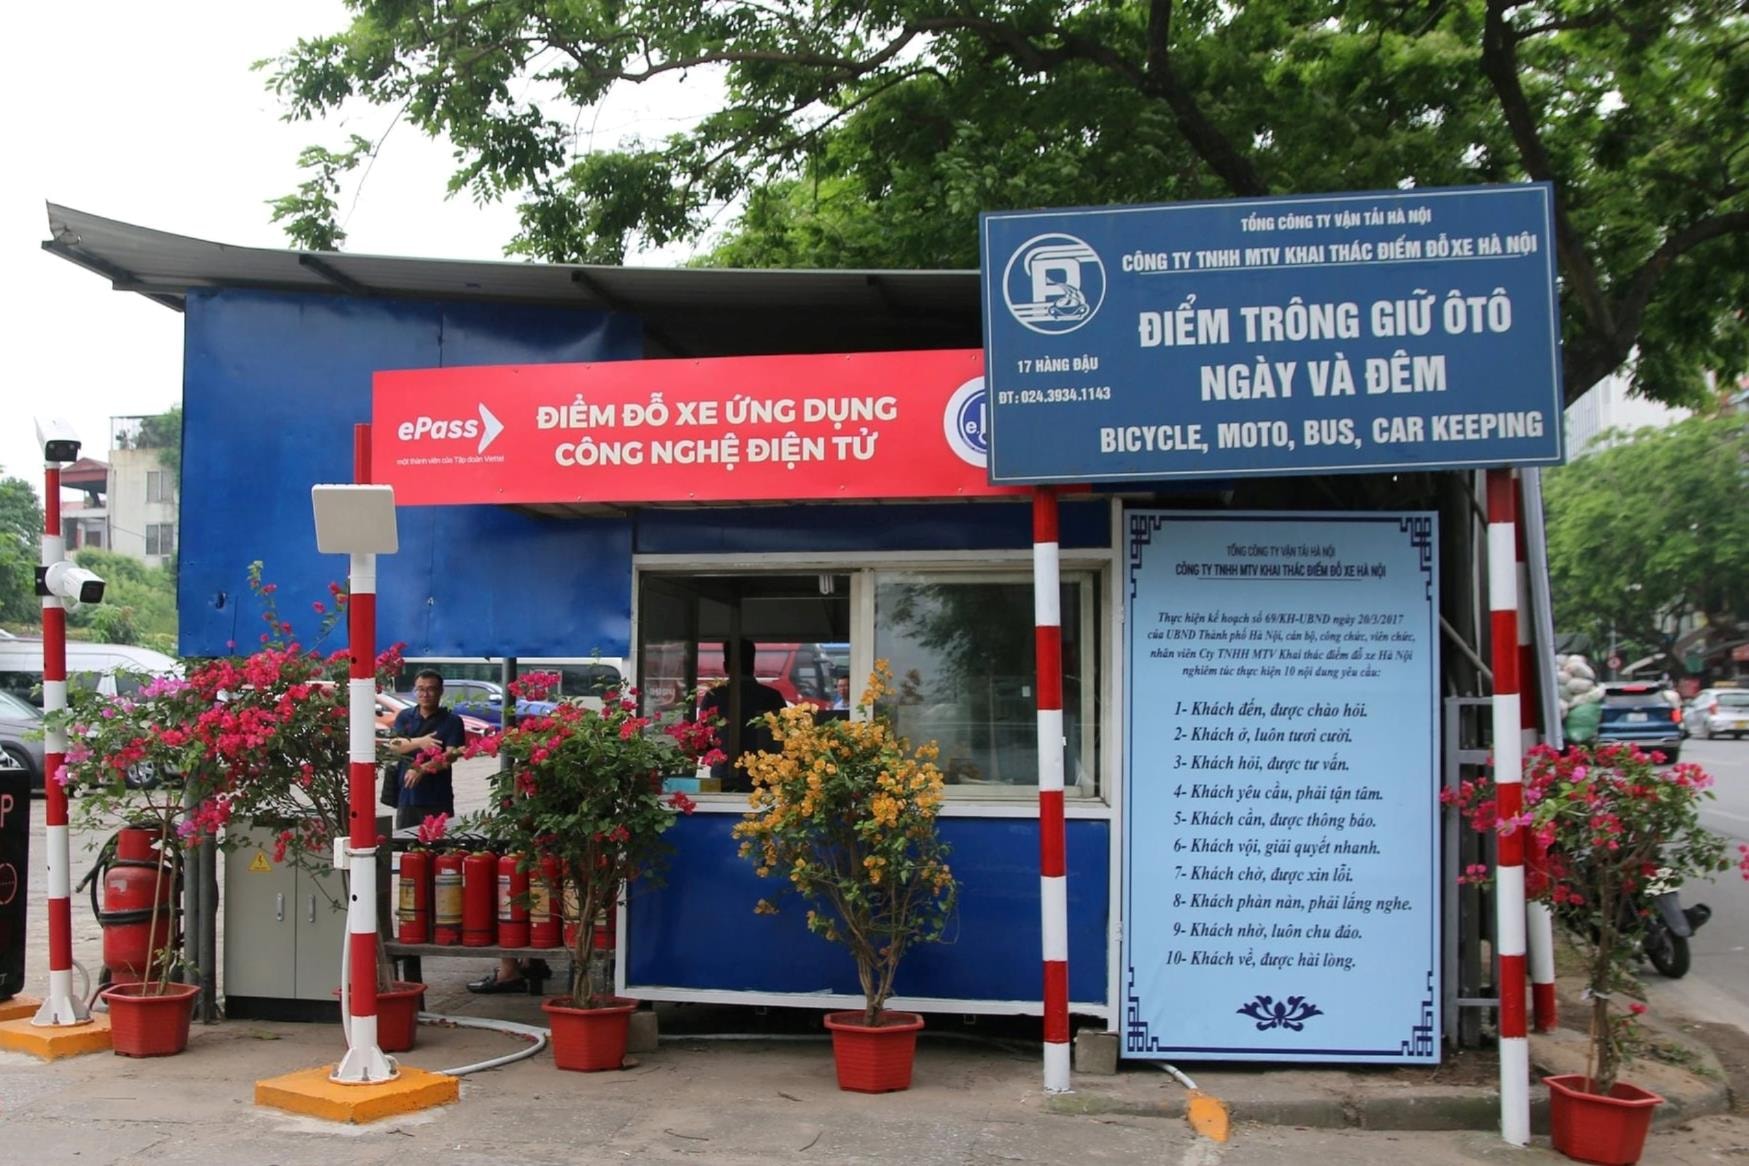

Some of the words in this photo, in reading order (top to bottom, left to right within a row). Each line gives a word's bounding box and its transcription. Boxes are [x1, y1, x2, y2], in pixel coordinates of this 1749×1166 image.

[1277, 212, 1313, 230] CÔNG
[1315, 213, 1331, 228] TY
[1333, 209, 1360, 229] VẬN
[1386, 207, 1405, 224] HÀ
[1407, 206, 1431, 225] NỘI
[1122, 250, 1168, 272] CÔNG
[1172, 251, 1191, 270] TY
[1195, 248, 1240, 268] TNHH
[1244, 247, 1280, 266] MTV
[1284, 244, 1325, 264] KHAI
[1330, 238, 1372, 262] THÁC
[1450, 238, 1473, 256] XE
[1478, 232, 1502, 255] HÀ
[1507, 230, 1537, 257] NỘI
[1138, 293, 1229, 348] ĐIỂM
[1239, 296, 1359, 342] TRÔNG
[1370, 288, 1436, 337] GIỮ
[1443, 286, 1511, 334] ÔTÔ
[1017, 359, 1032, 373] 17
[1035, 355, 1069, 372] HÀNG
[1072, 353, 1098, 373] ĐẬU
[1200, 357, 1296, 401] NGÀY
[1306, 354, 1356, 396] VÀ
[1364, 351, 1446, 394] ĐÊM
[535, 393, 615, 429] ĐIỂM
[621, 392, 669, 426] ĐỖ
[675, 400, 718, 425] XE
[725, 393, 795, 424] ỨNG
[803, 395, 897, 432] DỤNG
[397, 416, 479, 441] ePass
[1100, 424, 1208, 453] BICYCLE,
[1217, 420, 1295, 451] MOTO,
[1303, 418, 1361, 449] BUS,
[1372, 415, 1424, 443] CAR
[1431, 410, 1543, 441] KEEPING
[554, 434, 643, 466] CÔNG
[650, 432, 739, 472] NGHỆ
[745, 430, 824, 471] ĐIỆN
[831, 427, 878, 460] TỬ
[1190, 700, 1234, 716] Khách
[1237, 698, 1266, 718] đến,
[1269, 701, 1304, 720] được
[1306, 702, 1339, 717] chào
[1342, 702, 1367, 717] hỏi.
[1190, 726, 1234, 741] Khách
[1237, 727, 1250, 743] ở,
[1253, 727, 1285, 741] luôn
[1288, 727, 1316, 742] tươi
[1319, 728, 1352, 742] cười.
[1190, 754, 1234, 769] Khách
[1237, 755, 1262, 770] hỏi,
[1266, 755, 1300, 774] được
[1303, 759, 1320, 770] tư
[1322, 752, 1349, 770] vấn.
[1190, 783, 1233, 798] Khách
[1235, 784, 1261, 802] yêu
[1264, 784, 1292, 800] cầu,
[1295, 784, 1327, 803] phải
[1329, 785, 1351, 803] tận
[1354, 785, 1383, 800] tâm.
[1190, 810, 1233, 825] Khách
[1237, 808, 1265, 827] cần,
[1269, 811, 1303, 830] được
[1306, 812, 1345, 830] thông
[1348, 812, 1376, 827] báo.
[1190, 837, 1234, 853] Khách
[1238, 838, 1261, 856] vội,
[1264, 839, 1291, 857] giải
[1293, 839, 1330, 858] quyết
[1333, 839, 1380, 854] nhanh.
[1190, 865, 1234, 880] Khách
[1237, 865, 1266, 882] chờ,
[1270, 866, 1304, 885] được
[1306, 867, 1329, 881] xin
[1332, 863, 1353, 882] lỗi.
[1189, 892, 1233, 908] Khách
[1235, 893, 1271, 912] phàn
[1274, 894, 1304, 910] nàn,
[1307, 894, 1339, 913] phải
[1342, 892, 1372, 913] lắng
[1375, 895, 1412, 913] nghe.
[1189, 922, 1233, 936] Khách
[1236, 922, 1267, 938] nhờ,
[1270, 922, 1302, 938] luôn
[1305, 923, 1330, 938] chu
[1334, 924, 1362, 939] đáo.
[1190, 950, 1234, 965] Khách
[1238, 948, 1255, 967] về,
[1259, 951, 1294, 970] được
[1297, 951, 1320, 966] hài
[1322, 952, 1355, 970] lòng.
